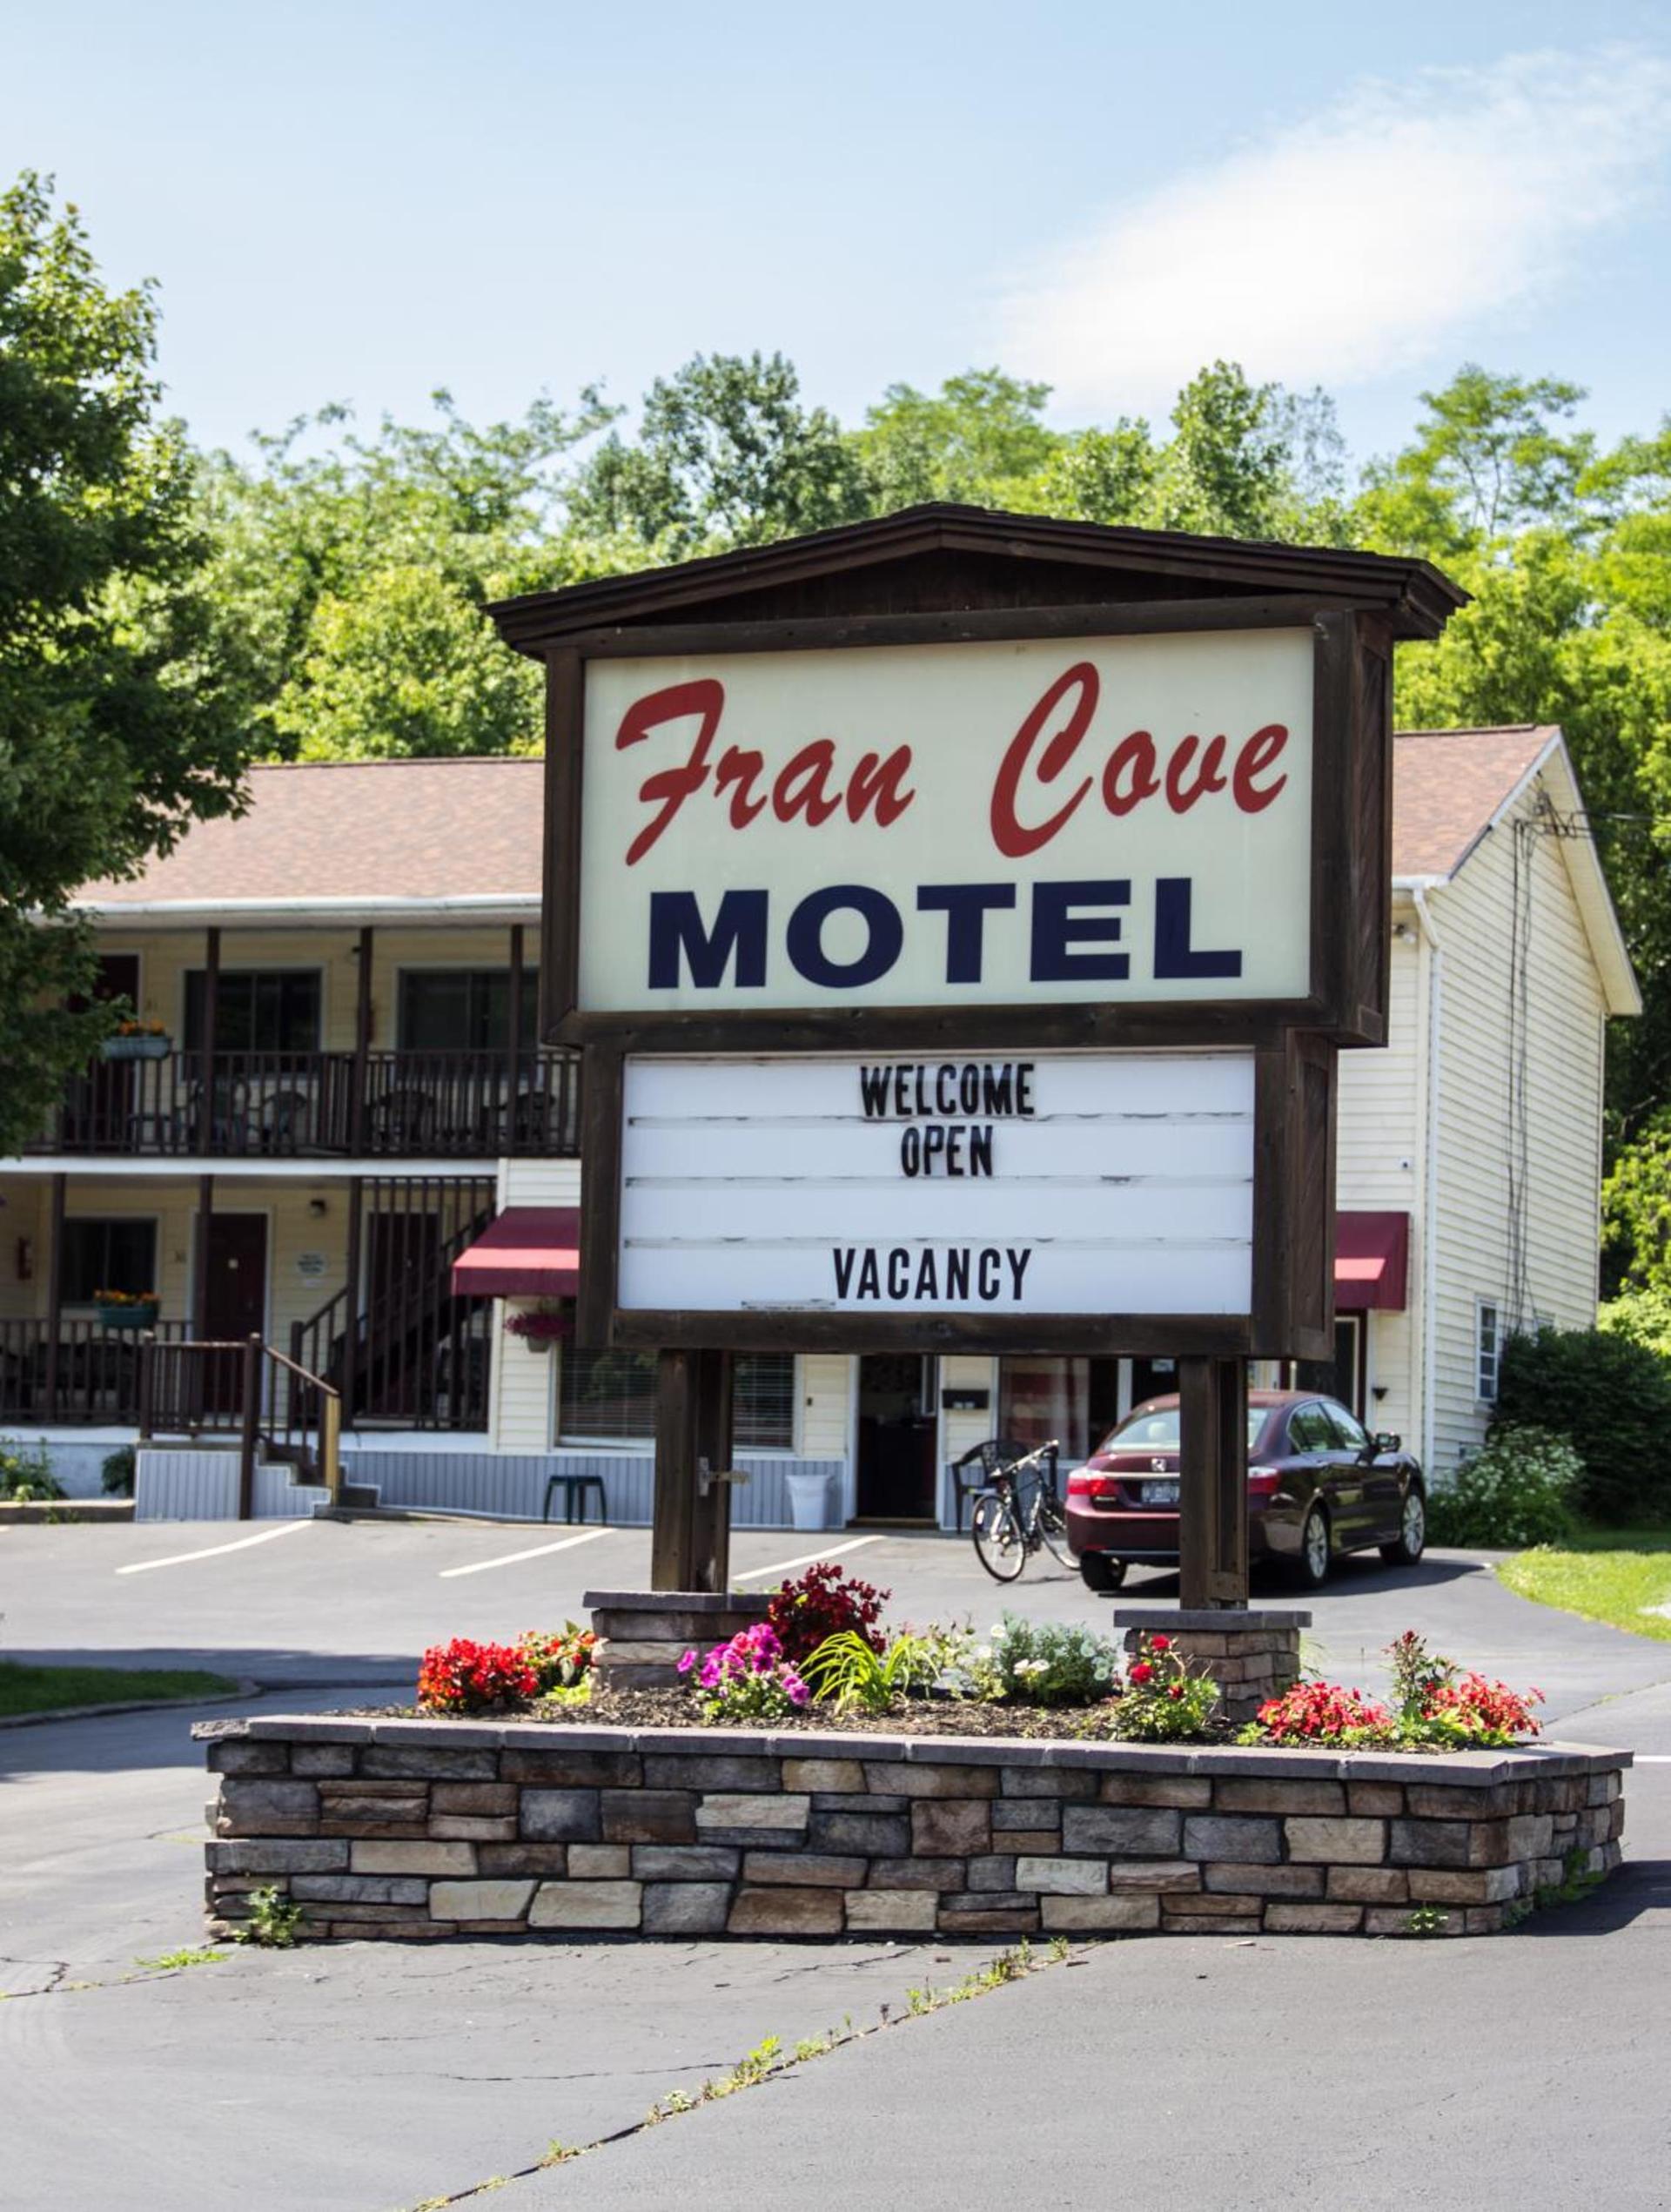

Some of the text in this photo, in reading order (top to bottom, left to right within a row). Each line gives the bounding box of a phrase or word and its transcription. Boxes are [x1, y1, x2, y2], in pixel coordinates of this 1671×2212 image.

[615, 662, 1288, 866] Fran Cove
[648, 877, 1243, 990] MOTEL
[859, 1062, 1036, 1117] WELCOME
[900, 1125, 994, 1178] OPEN
[832, 1247, 1032, 1301] VACANCY
